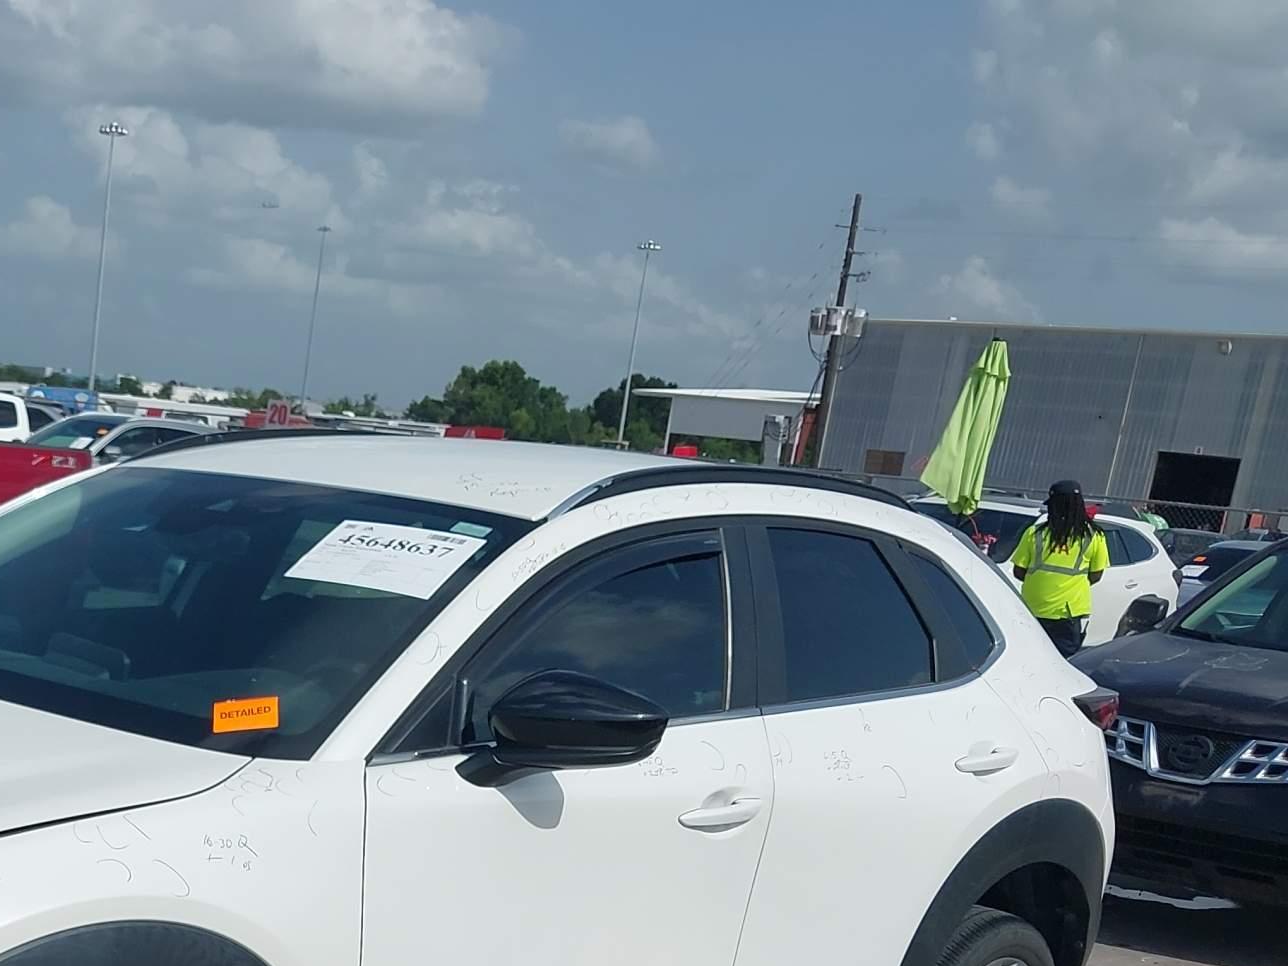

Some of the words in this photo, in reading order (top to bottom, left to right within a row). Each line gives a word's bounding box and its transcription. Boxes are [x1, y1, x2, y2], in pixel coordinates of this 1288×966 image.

[268, 404, 287, 425] 20
[338, 534, 455, 559] 45648637
[219, 706, 272, 720] DETAILED
